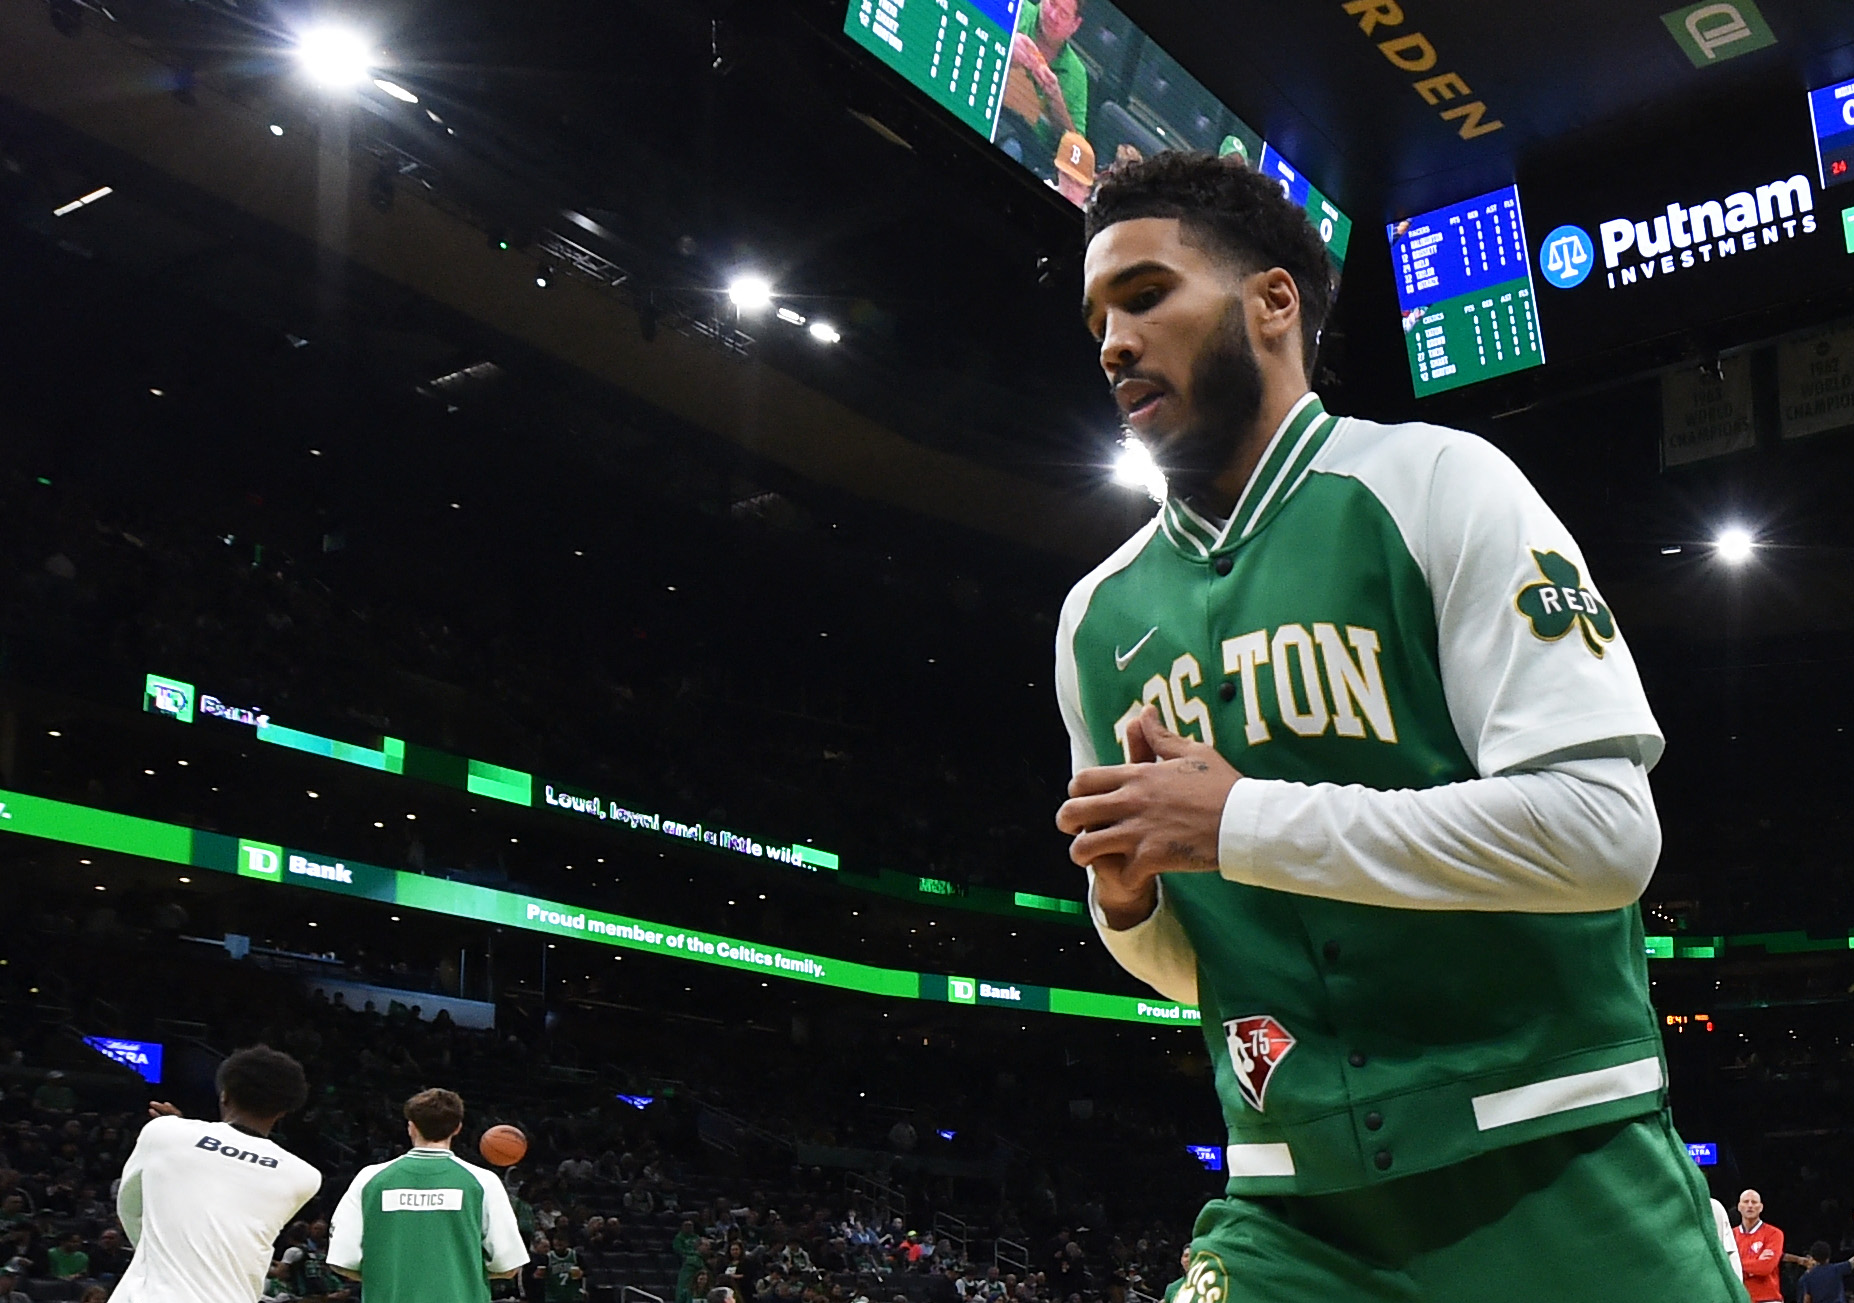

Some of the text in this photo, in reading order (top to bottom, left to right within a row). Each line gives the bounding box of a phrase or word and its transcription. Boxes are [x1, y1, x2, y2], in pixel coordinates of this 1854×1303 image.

[1831, 160, 1847, 175] 24
[1600, 174, 1813, 269] Putnam
[1607, 215, 1816, 289] INVESTMENTS
[1801, 373, 1852, 398] WORLD
[1539, 587, 1598, 614] RED
[545, 784, 606, 820] Loud,
[242, 846, 353, 884] TD Bank
[526, 903, 826, 978] Proud member of the Celtics family.
[950, 980, 1021, 1001] TD Bank
[1137, 1002, 1180, 1020] Proud
[1666, 1015, 1687, 1025] 8:41
[1248, 1028, 1271, 1058] 75
[195, 1136, 279, 1169] Bona
[399, 1193, 444, 1206] CELTICS
[1565, 1274, 1575, 1286] 7
